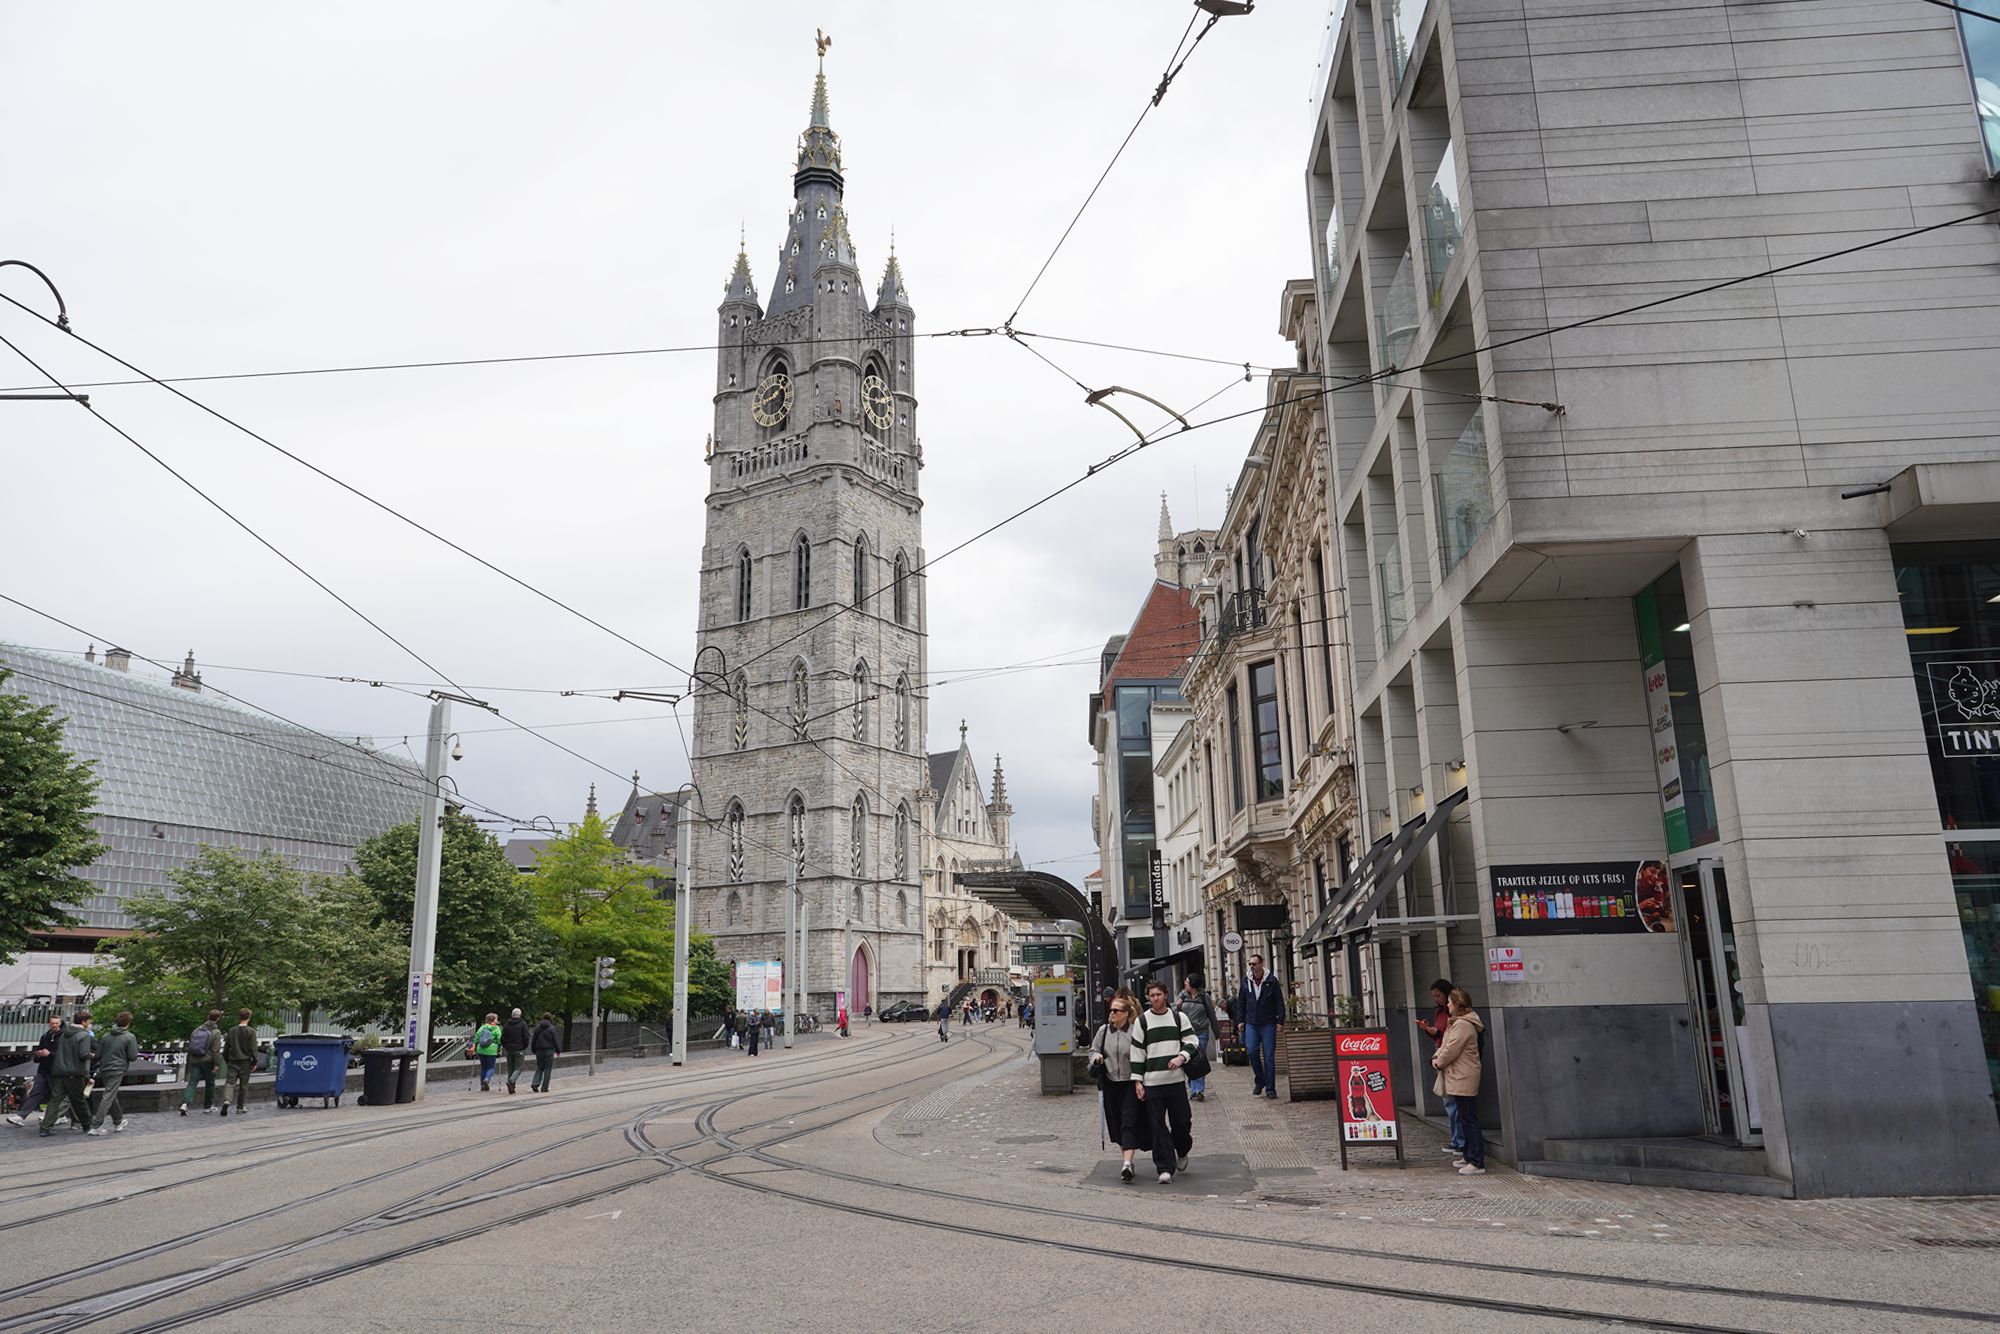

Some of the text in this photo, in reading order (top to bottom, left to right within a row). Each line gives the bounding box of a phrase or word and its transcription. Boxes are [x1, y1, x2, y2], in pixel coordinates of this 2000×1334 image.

[1153, 859, 1163, 908] Leonidas
[1497, 873, 1626, 887] TRAKTEER JEZELF OP IETS FRIS!
[153, 1053, 169, 1065] AFE
